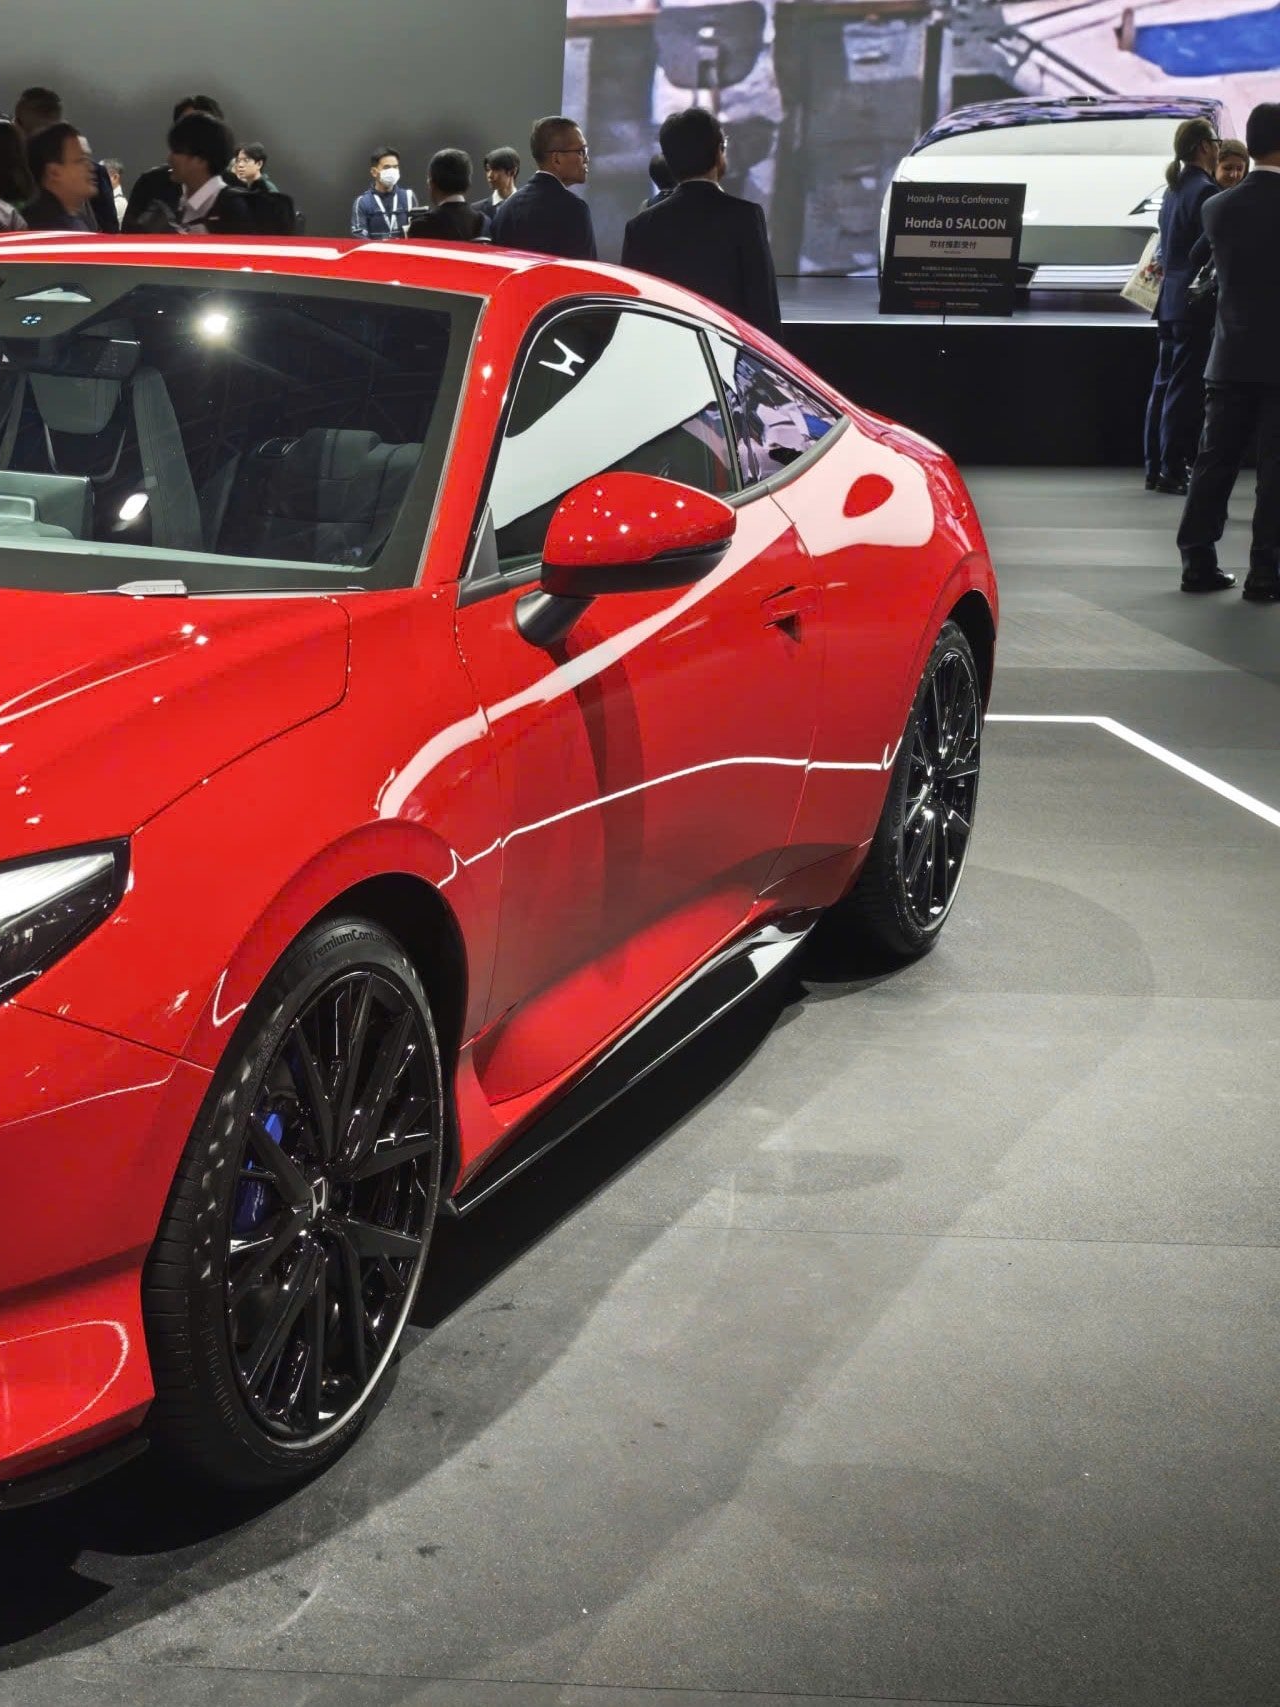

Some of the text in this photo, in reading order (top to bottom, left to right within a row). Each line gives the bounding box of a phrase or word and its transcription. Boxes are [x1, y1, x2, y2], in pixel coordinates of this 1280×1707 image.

[906, 194, 1010, 205] Honda Press Conference
[904, 217, 1007, 230] Honda 0 SALOON
[305, 929, 384, 966] PremiumConta
